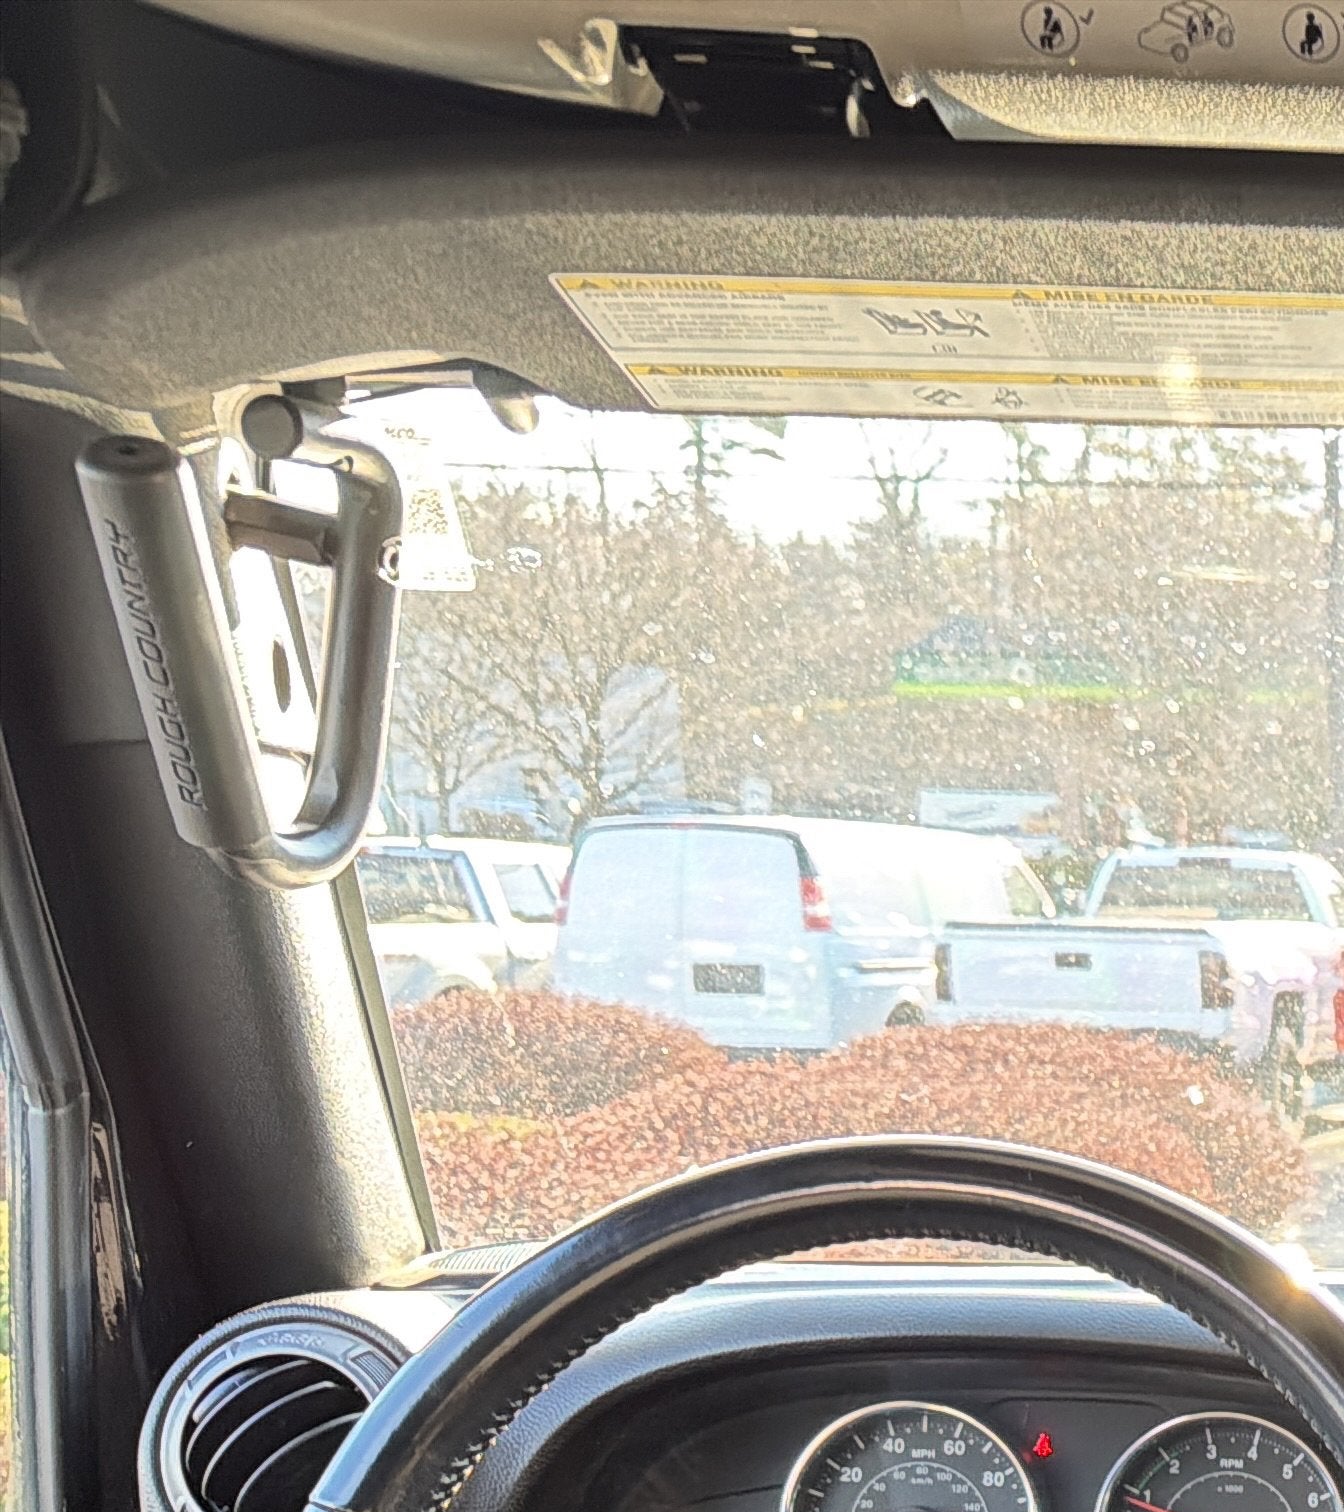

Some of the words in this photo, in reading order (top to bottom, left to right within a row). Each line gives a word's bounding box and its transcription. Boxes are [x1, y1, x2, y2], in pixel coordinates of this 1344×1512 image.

[104, 517, 171, 688] COUNTRY
[152, 693, 207, 810] ROUGH
[883, 1438, 904, 1454] 40
[943, 1440, 965, 1455] 60
[1206, 1445, 1217, 1459] 3
[1248, 1446, 1258, 1460] 4
[912, 1450, 936, 1459] MPH
[1169, 1460, 1180, 1474] 2
[1220, 1459, 1244, 1469] RPM
[1282, 1464, 1293, 1479] 5
[840, 1467, 862, 1483] 20
[983, 1471, 1004, 1487] 80
[1308, 1493, 1319, 1508] 6
